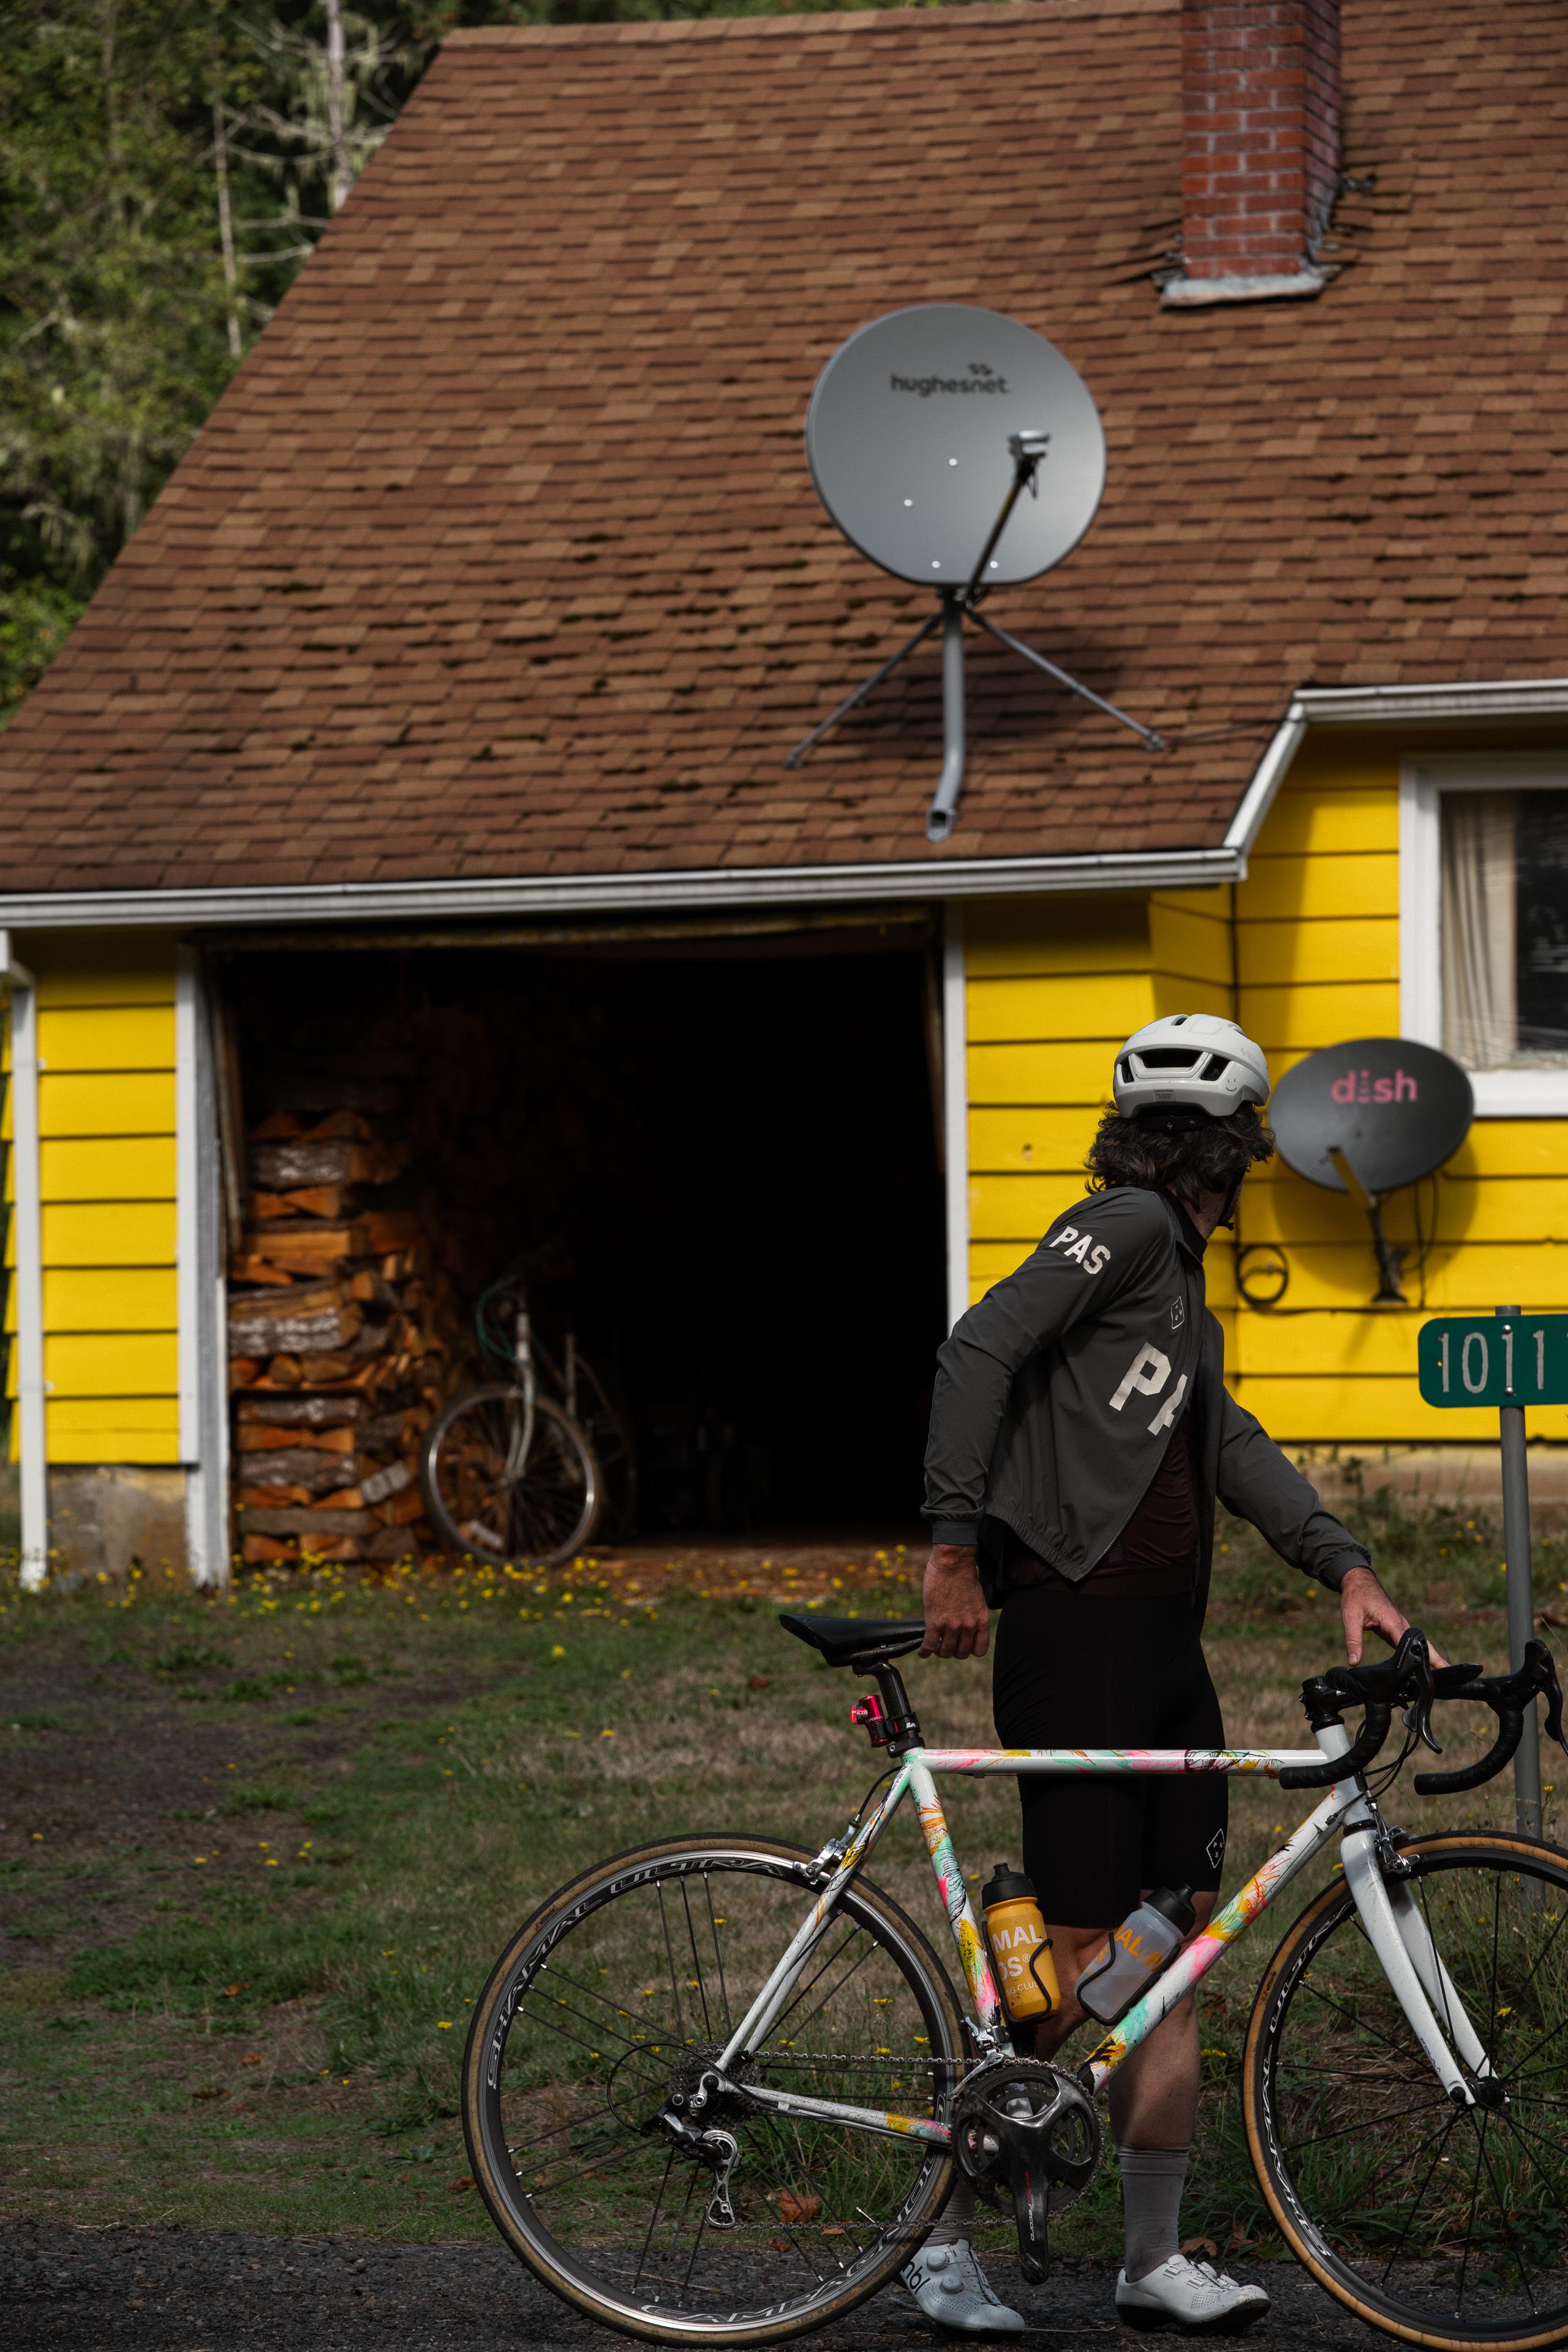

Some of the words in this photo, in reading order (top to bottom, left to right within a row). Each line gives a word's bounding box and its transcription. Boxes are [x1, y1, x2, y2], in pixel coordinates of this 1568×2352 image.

[891, 374, 1008, 398] hughesnet
[1331, 1069, 1417, 1104] dish
[1049, 1226, 1111, 1275] PAS
[1438, 1329, 1568, 1395] 1011
[992, 1924, 1043, 1954] MAL
[1115, 1924, 1142, 1957] AL
[487, 1899, 602, 2090] SHAMAL
[610, 1858, 785, 1894] ULTRA
